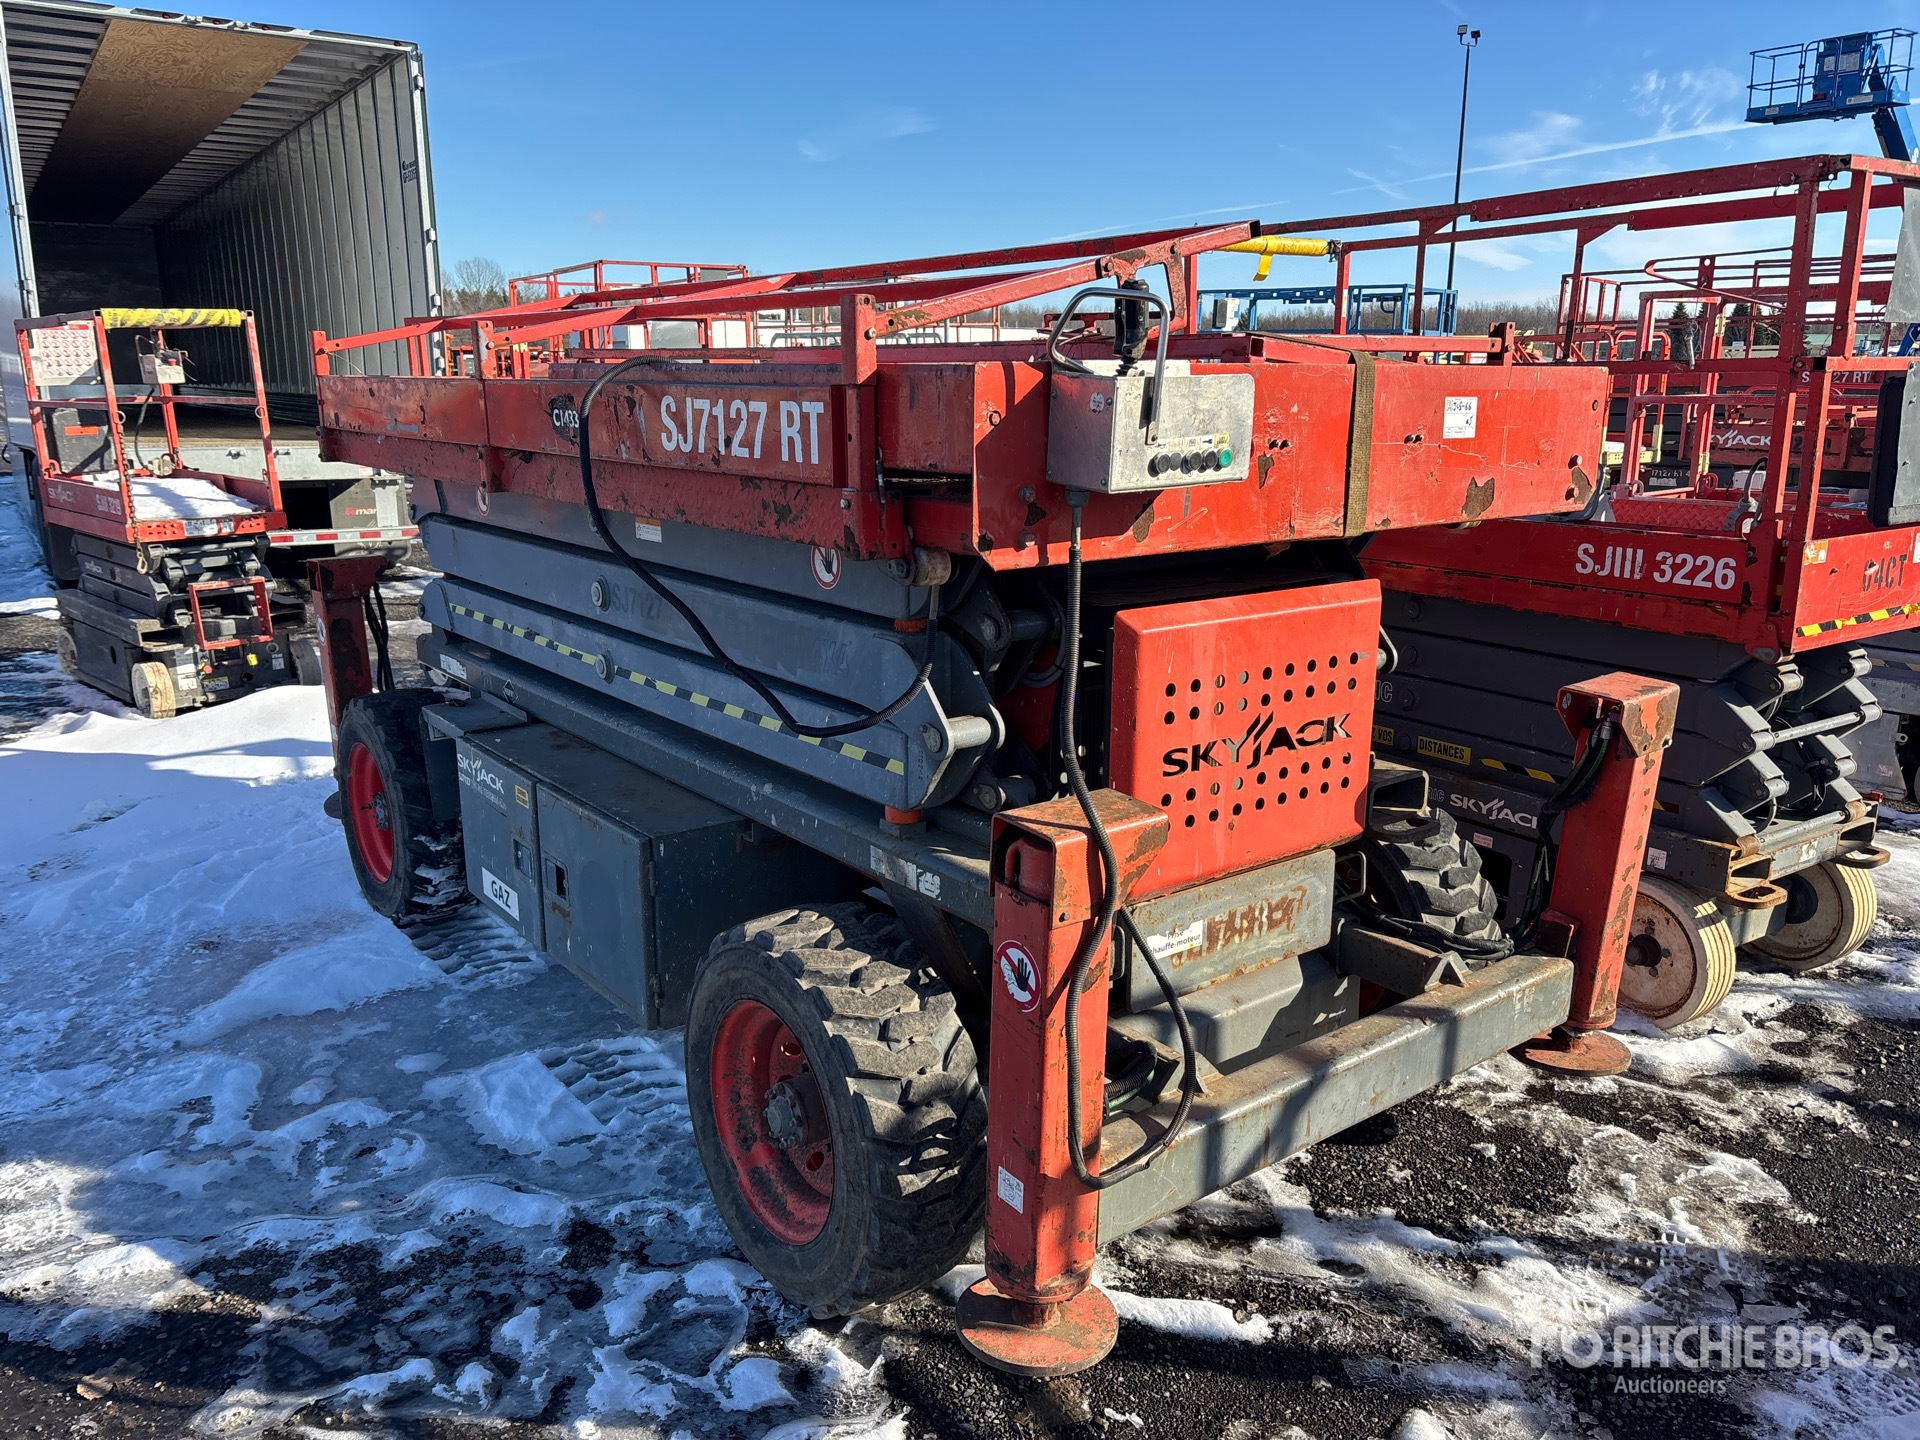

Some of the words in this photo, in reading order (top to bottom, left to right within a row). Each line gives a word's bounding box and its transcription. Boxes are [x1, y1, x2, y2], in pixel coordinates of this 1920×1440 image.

[1853, 371, 1870, 383] RT
[661, 395, 767, 459] SJ7127
[779, 400, 824, 465] RT
[1653, 551, 1737, 590] 3226
[1162, 711, 1352, 777] SKYJACK
[1378, 730, 1393, 742] VOS
[1419, 738, 1465, 761] DISTANCES
[457, 753, 505, 794] SKYJACK
[491, 880, 511, 909] GAZ
[1152, 933, 1202, 954] hauffe-moteur
